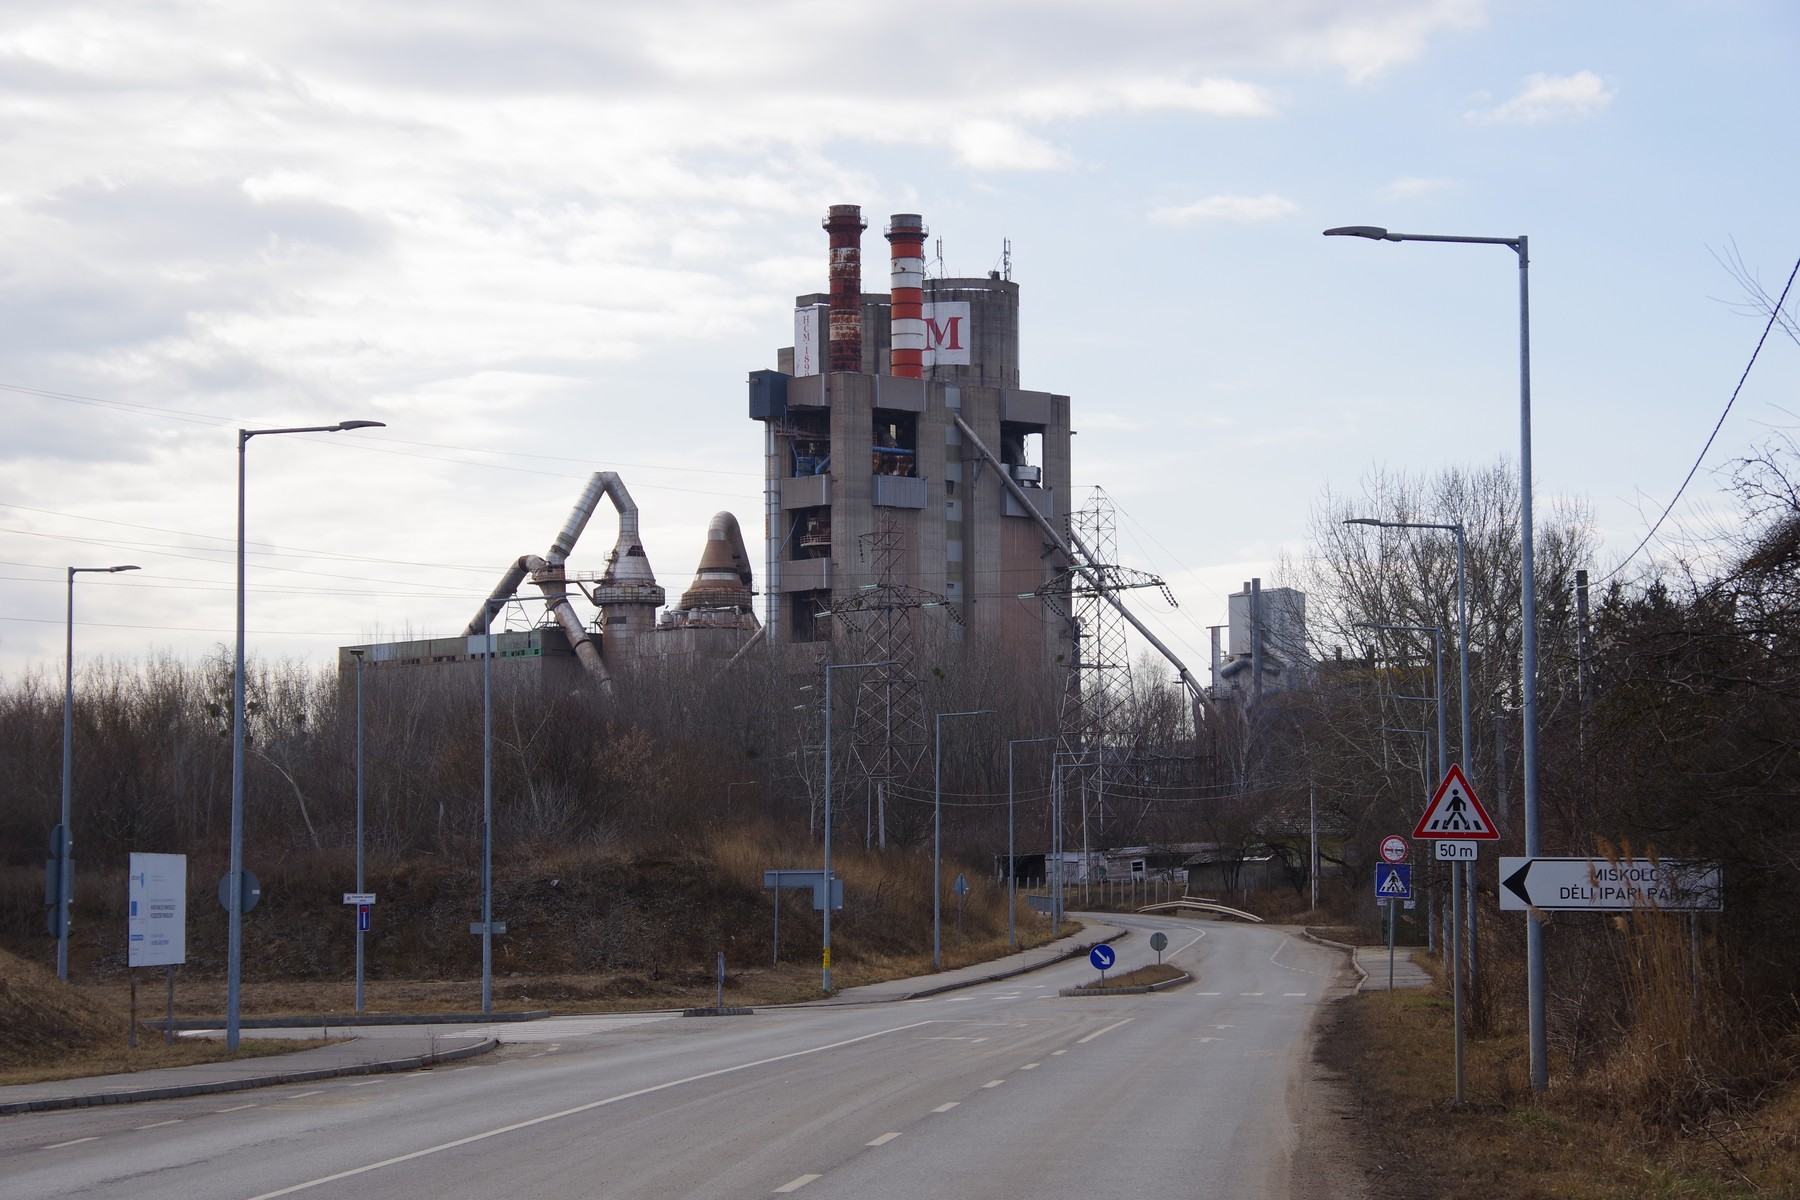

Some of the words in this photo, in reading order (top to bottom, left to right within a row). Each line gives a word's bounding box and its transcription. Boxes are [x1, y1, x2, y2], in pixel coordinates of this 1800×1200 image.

[1440, 844, 1456, 857] 50
[1460, 847, 1473, 857] m
[1560, 884, 1594, 899] DÉLI
